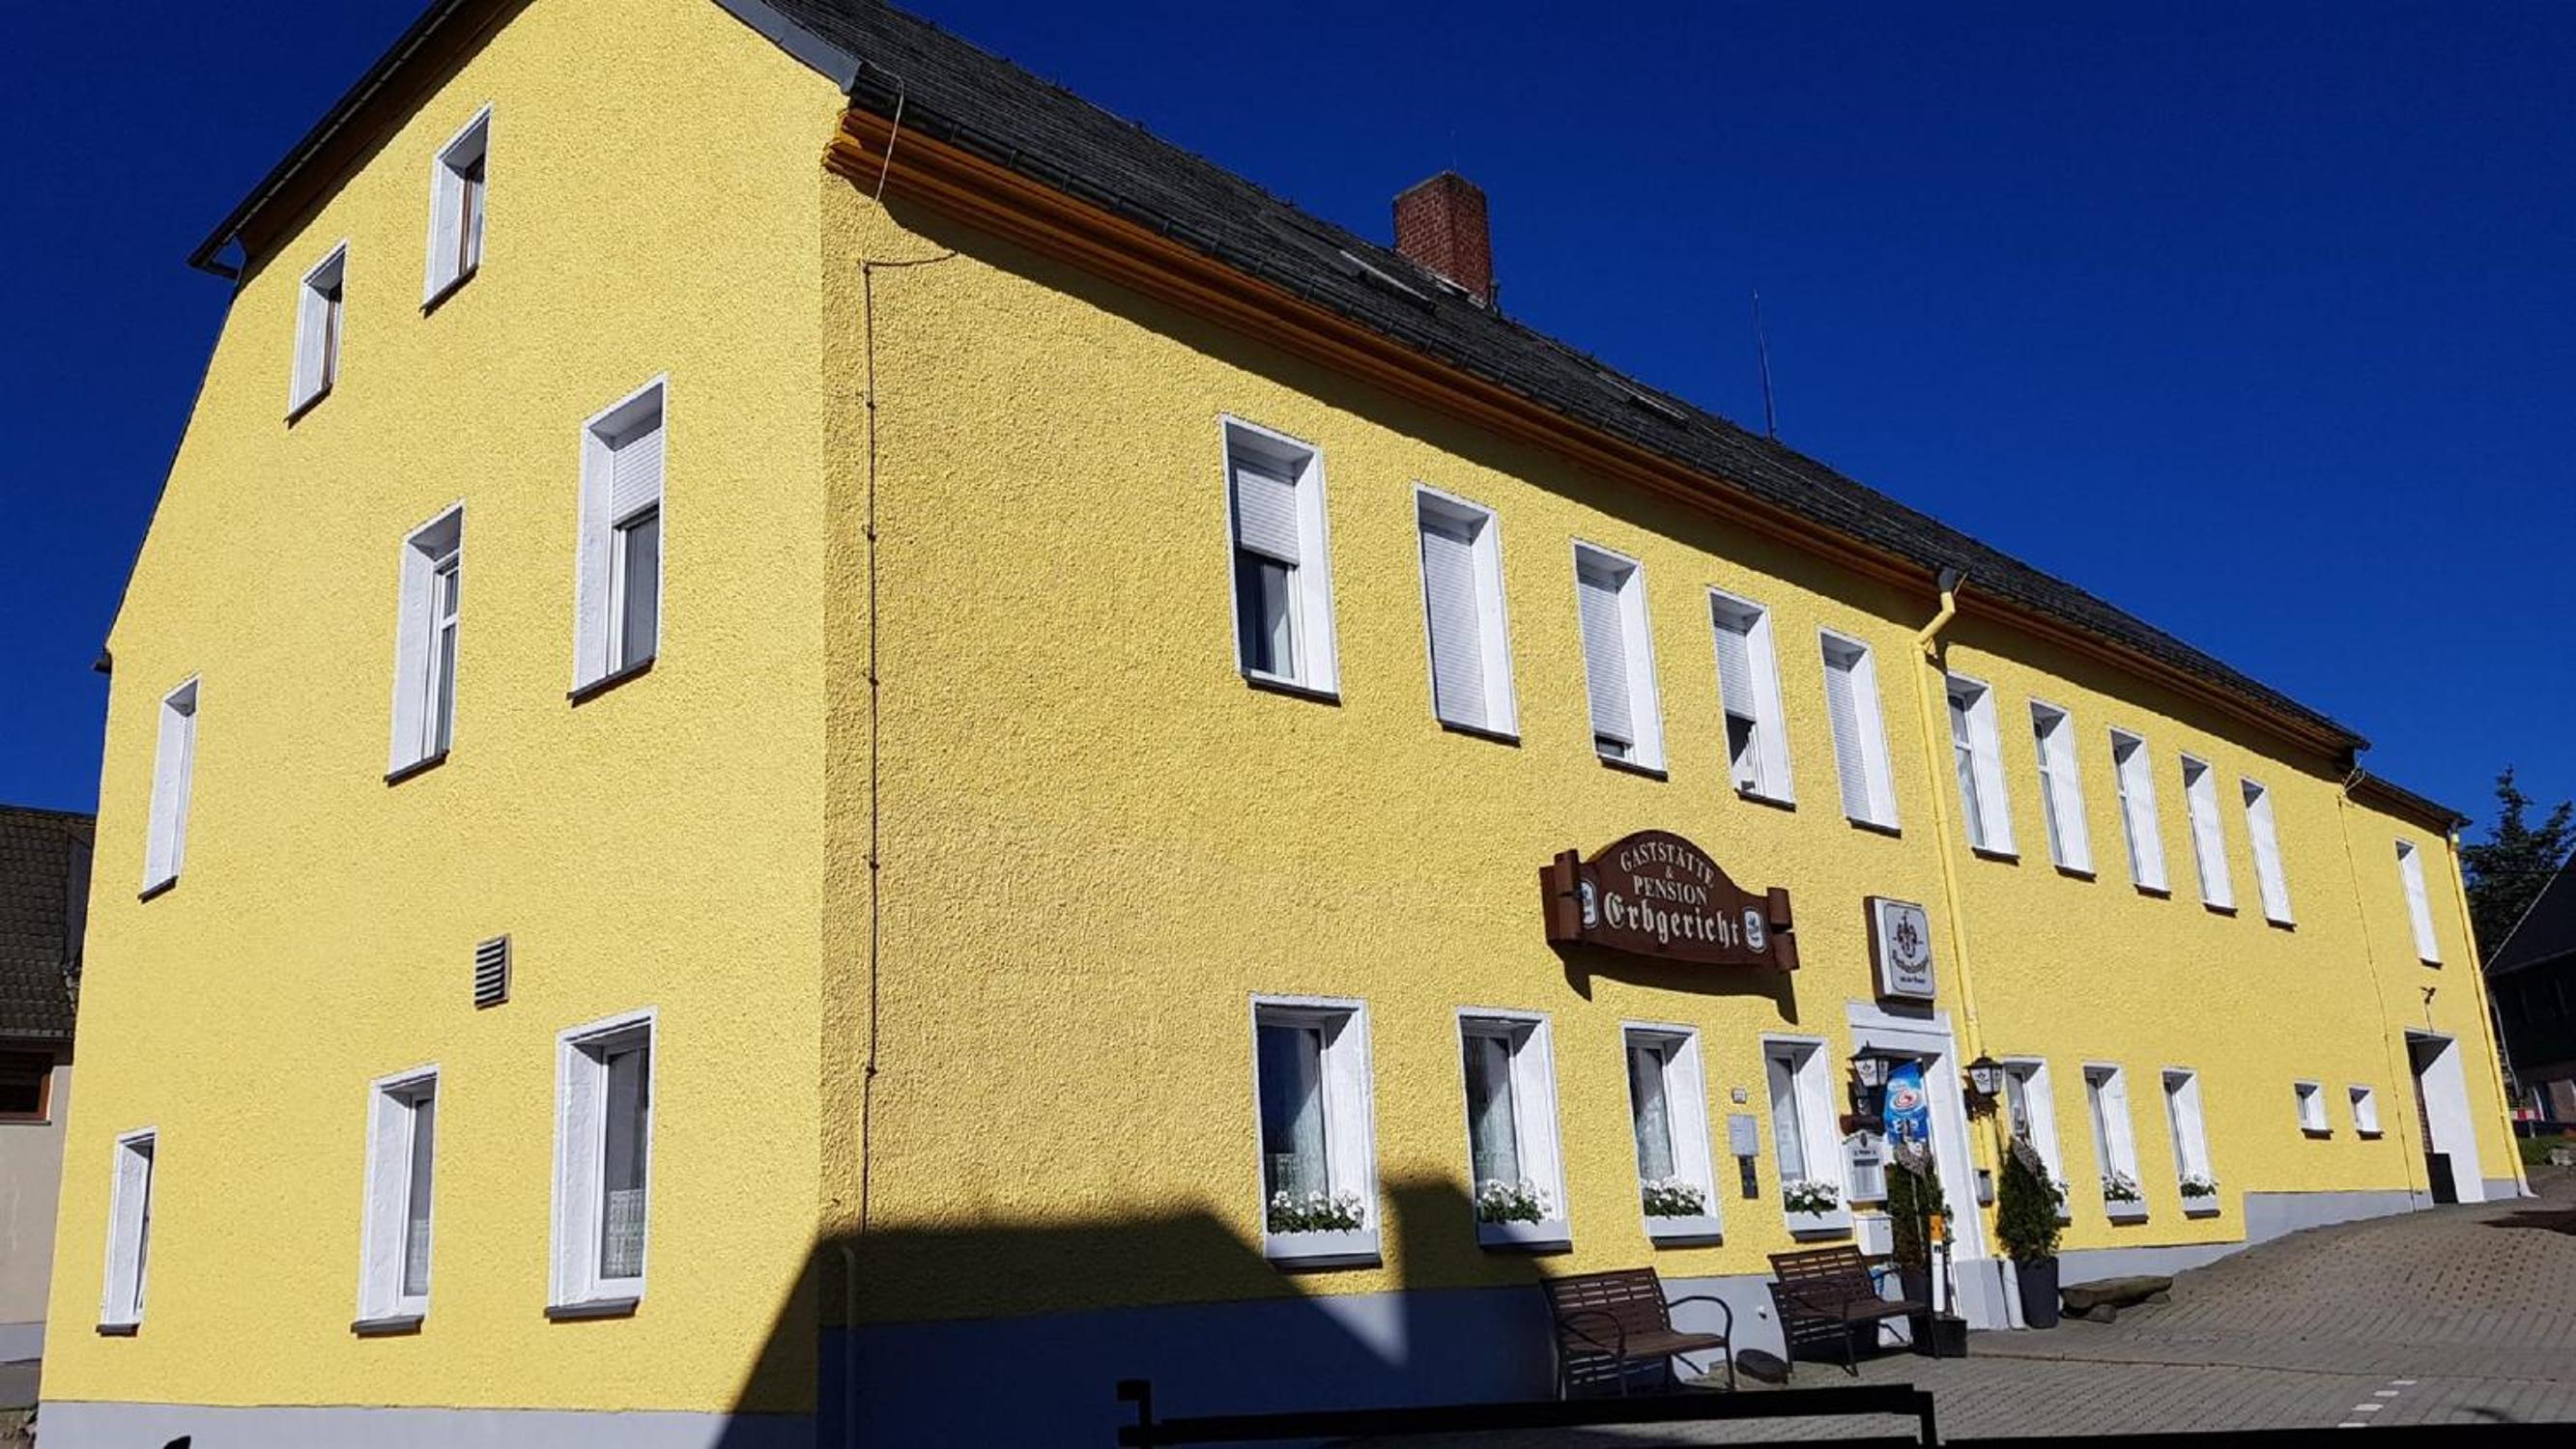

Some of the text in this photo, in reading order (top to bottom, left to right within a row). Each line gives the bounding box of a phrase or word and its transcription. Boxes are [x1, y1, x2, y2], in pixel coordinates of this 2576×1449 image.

[1620, 842, 1714, 889] GASTSTÄTTE
[1665, 865, 1674, 880] &
[1633, 874, 1708, 906] PENSION
[1604, 892, 1739, 949] Erbgericht
